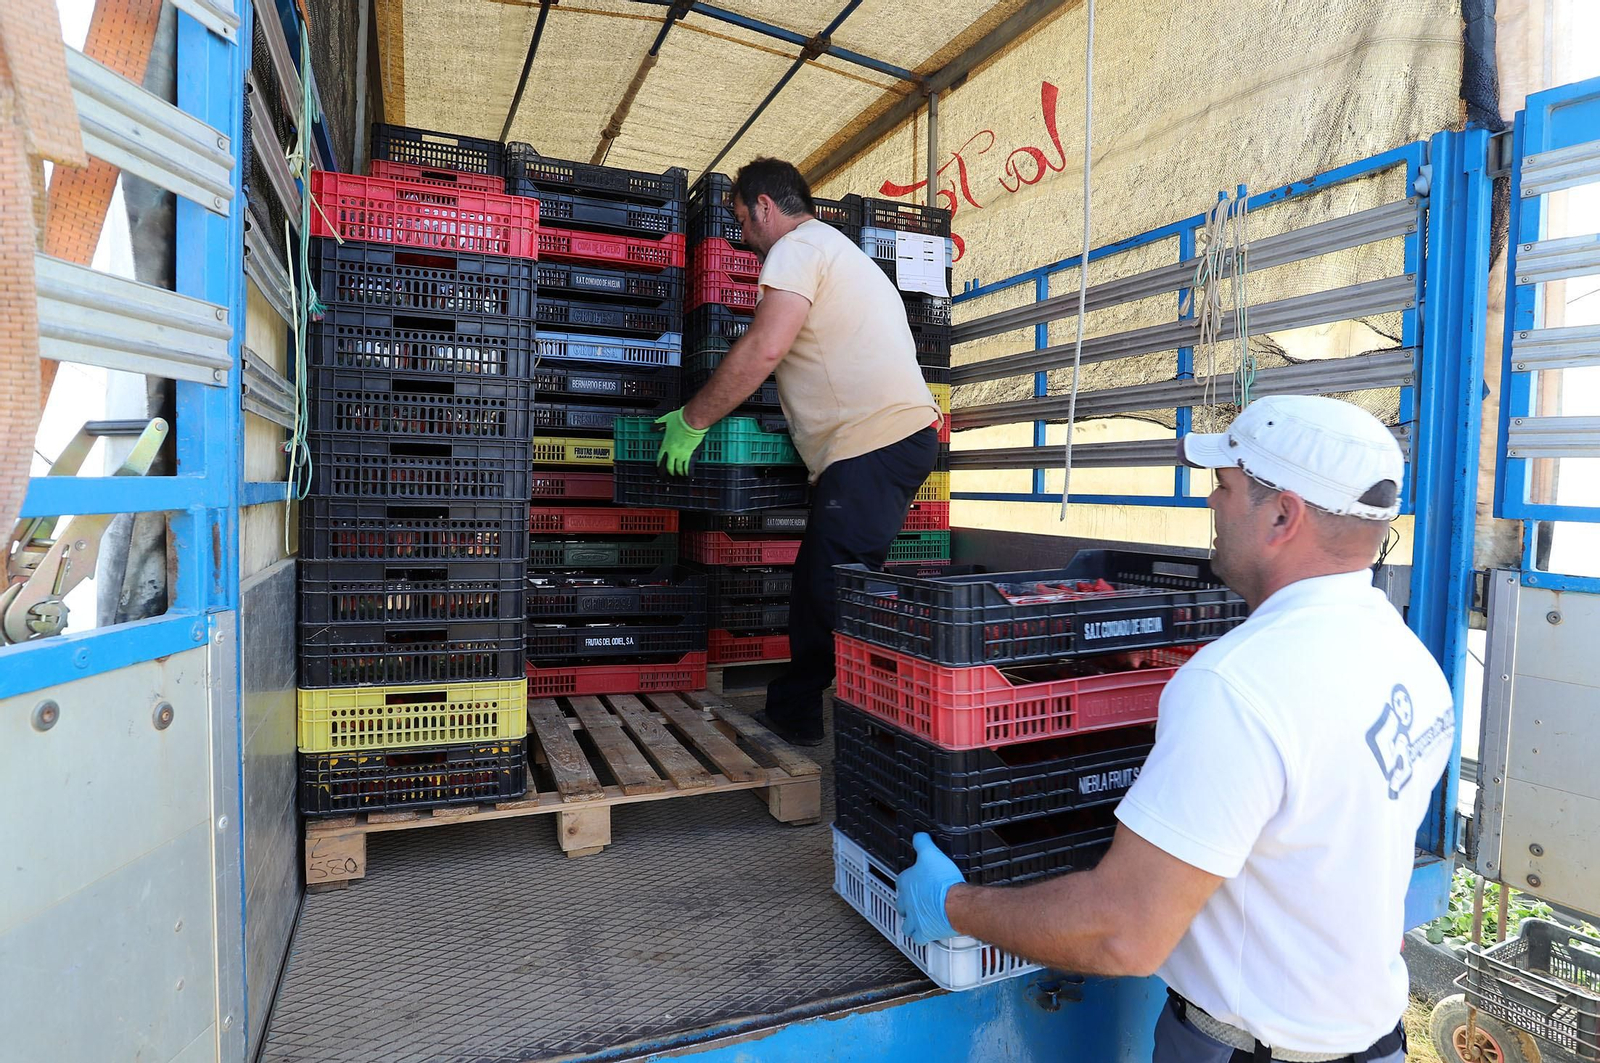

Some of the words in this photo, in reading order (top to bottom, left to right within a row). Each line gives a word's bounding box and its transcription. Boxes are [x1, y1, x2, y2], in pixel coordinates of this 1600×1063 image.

[571, 379, 598, 389] BERNARDO
[602, 381, 616, 390] HIJOS
[574, 447, 592, 455] FRUTAS
[585, 638, 602, 647] FRUTAS
[602, 637, 611, 646] DEL
[1078, 772, 1108, 794] NIEBLA
[309, 857, 358, 878] 580
